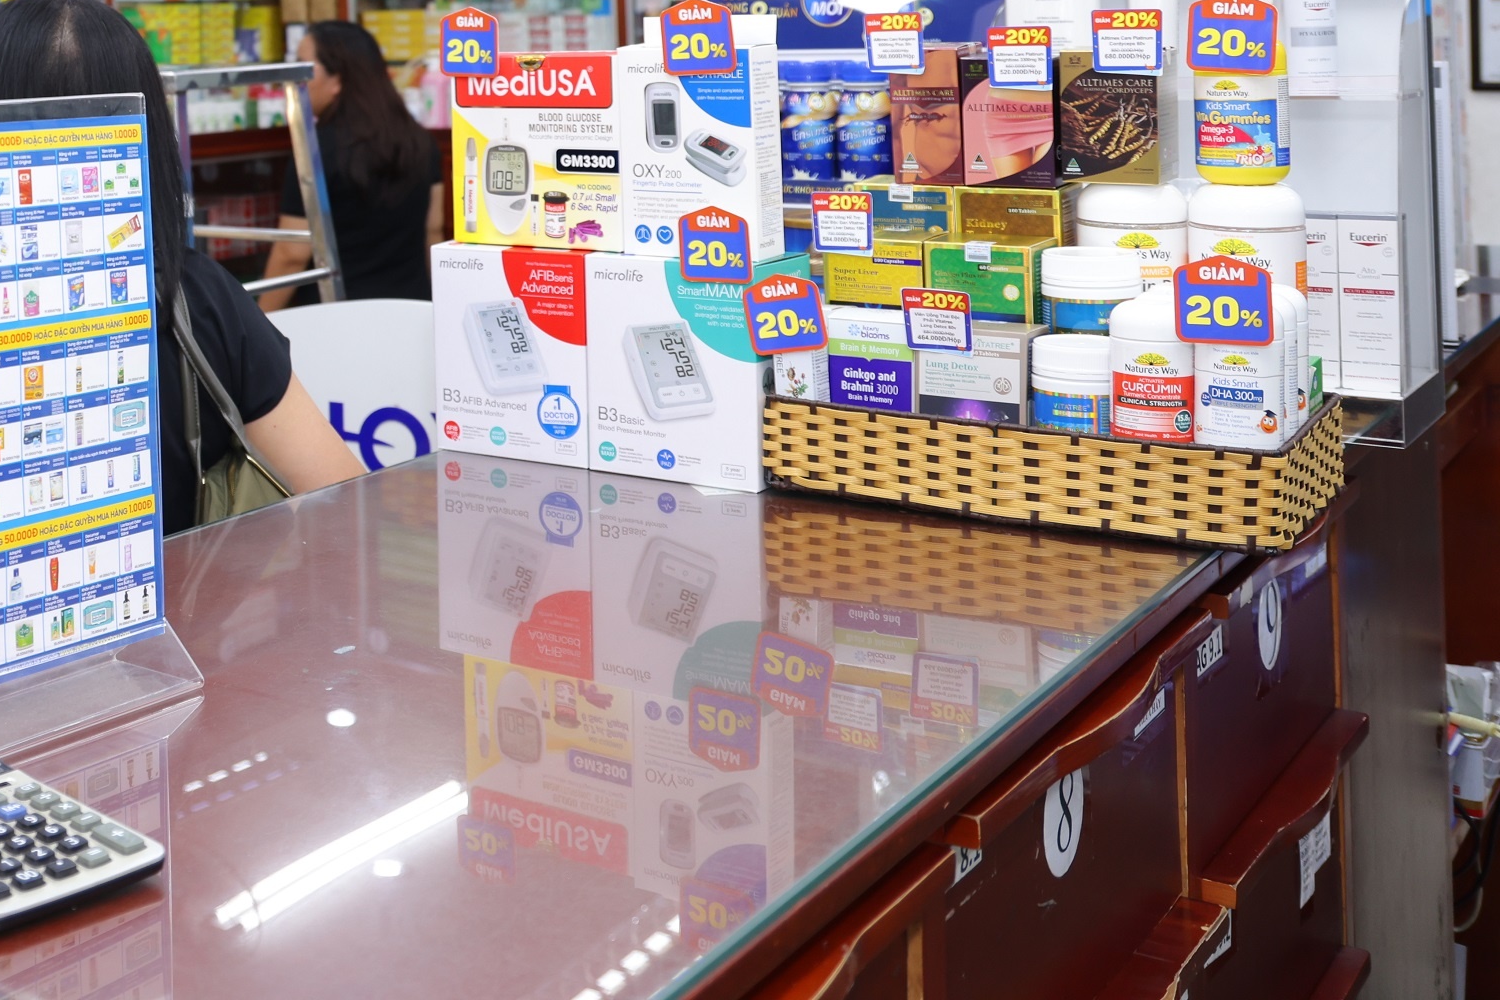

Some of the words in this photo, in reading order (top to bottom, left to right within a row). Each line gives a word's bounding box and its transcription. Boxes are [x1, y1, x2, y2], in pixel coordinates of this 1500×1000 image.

[678, 4, 712, 21] GIẢM
[1111, 11, 1159, 28] 20%
[455, 13, 484, 28] GIẢM
[881, 14, 920, 30] 20%
[1005, 28, 1049, 45] 20%
[1196, 27, 1267, 58] 20%
[446, 38, 493, 64] 20%
[670, 32, 727, 60] 20%
[467, 68, 597, 97] MediUSA
[1075, 78, 1124, 87] ALLTIMES
[1125, 78, 1154, 87] CARE
[1106, 86, 1154, 94] CORDYCEPS
[933, 89, 955, 97] CARE
[1206, 89, 1232, 97] Nature's
[1233, 89, 1249, 99] Way
[966, 103, 1018, 113] ALLTIMES
[1020, 104, 1050, 113] CARE
[1205, 101, 1222, 110] Kids
[1223, 102, 1251, 111] Smart
[538, 113, 563, 122] BLOOD
[566, 113, 602, 123] GLUCOSE
[1209, 111, 1272, 126] Gummies
[528, 124, 577, 133] MONITORING
[580, 124, 613, 134] SYSTEM
[1200, 124, 1234, 134] Omega-3
[23, 134, 43, 147] HOẶC
[59, 130, 82, 144] QUYỀN
[82, 132, 95, 142] MUA
[95, 129, 114, 141] HÀNG
[114, 128, 138, 140] 1.000Đ
[1200, 135, 1212, 143] DHA
[1213, 134, 1225, 143] Fish
[1225, 134, 1236, 143] Oil
[560, 153, 616, 169] GM3300
[632, 163, 665, 179] OXY
[665, 170, 682, 179] 200
[595, 193, 617, 202] Small
[828, 194, 869, 211] 20%
[596, 203, 619, 213] Rapid
[696, 211, 730, 229] GIẢM
[965, 218, 1008, 230] Kidney
[1349, 231, 1388, 243] Eucerin
[687, 239, 745, 268] 20%
[1149, 249, 1171, 261] Way
[439, 258, 484, 271] microlife
[833, 266, 856, 276] Super
[857, 268, 879, 276] Liver
[1199, 262, 1245, 281] GIẢM
[528, 269, 574, 283] AFIBsens
[594, 268, 644, 283] microlife
[833, 274, 857, 283] Detox
[520, 281, 574, 296] Advanced
[677, 283, 744, 299] SmartMAM
[761, 280, 798, 298] GIẢM
[921, 291, 967, 311] 20%
[1186, 294, 1263, 328] 20%
[34, 328, 53, 342] HOẶC
[69, 322, 91, 336] QUYỀN
[91, 323, 105, 332] MUA
[105, 318, 124, 331] HÀNG
[124, 314, 149, 327] 1.000Đ
[755, 308, 818, 340] 20%
[860, 330, 890, 341] blooms
[839, 342, 860, 353] Brain
[869, 345, 900, 358] Memory
[925, 359, 949, 371] Lung
[950, 361, 979, 372] Detox
[1124, 363, 1160, 375] Nature's
[1160, 366, 1179, 377] Way
[1213, 362, 1242, 373] Nature's
[1242, 365, 1258, 374] Way
[843, 367, 876, 383] Ginkgo
[877, 370, 896, 382] and
[1212, 376, 1231, 386] Kids
[1232, 378, 1259, 389] Smart
[840, 380, 874, 394] Brahmi
[875, 383, 899, 396] 3000
[1121, 380, 1182, 394] CURCUMIN
[1123, 390, 1146, 399] Turmeric
[442, 387, 462, 403] B3
[462, 395, 483, 406] AFIB
[484, 398, 527, 412] Advanced
[847, 393, 865, 401] Brain
[872, 395, 894, 405] Memory
[1120, 396, 1148, 406] CLINICAL
[1149, 400, 1183, 408] STRENGTH
[1211, 387, 1233, 400] DHA
[1234, 389, 1263, 403] 300mg
[460, 406, 484, 416] Pressure
[484, 409, 506, 418] Monitor
[543, 411, 575, 420] DOCTOR
[597, 405, 618, 422] B3
[619, 414, 645, 426] Basic
[597, 423, 616, 432] Blood
[616, 426, 643, 436] Pressure
[643, 429, 667, 439] Monitor
[4, 527, 39, 545] 50.000Đ
[39, 523, 59, 537] HOẶC
[74, 514, 97, 531] QUYỀN
[97, 513, 110, 524] MUA
[110, 507, 129, 521] HÀNG
[128, 499, 153, 515] 1.000Đ
[1208, 632, 1222, 662] 9.1
[1056, 772, 1074, 854] 8
